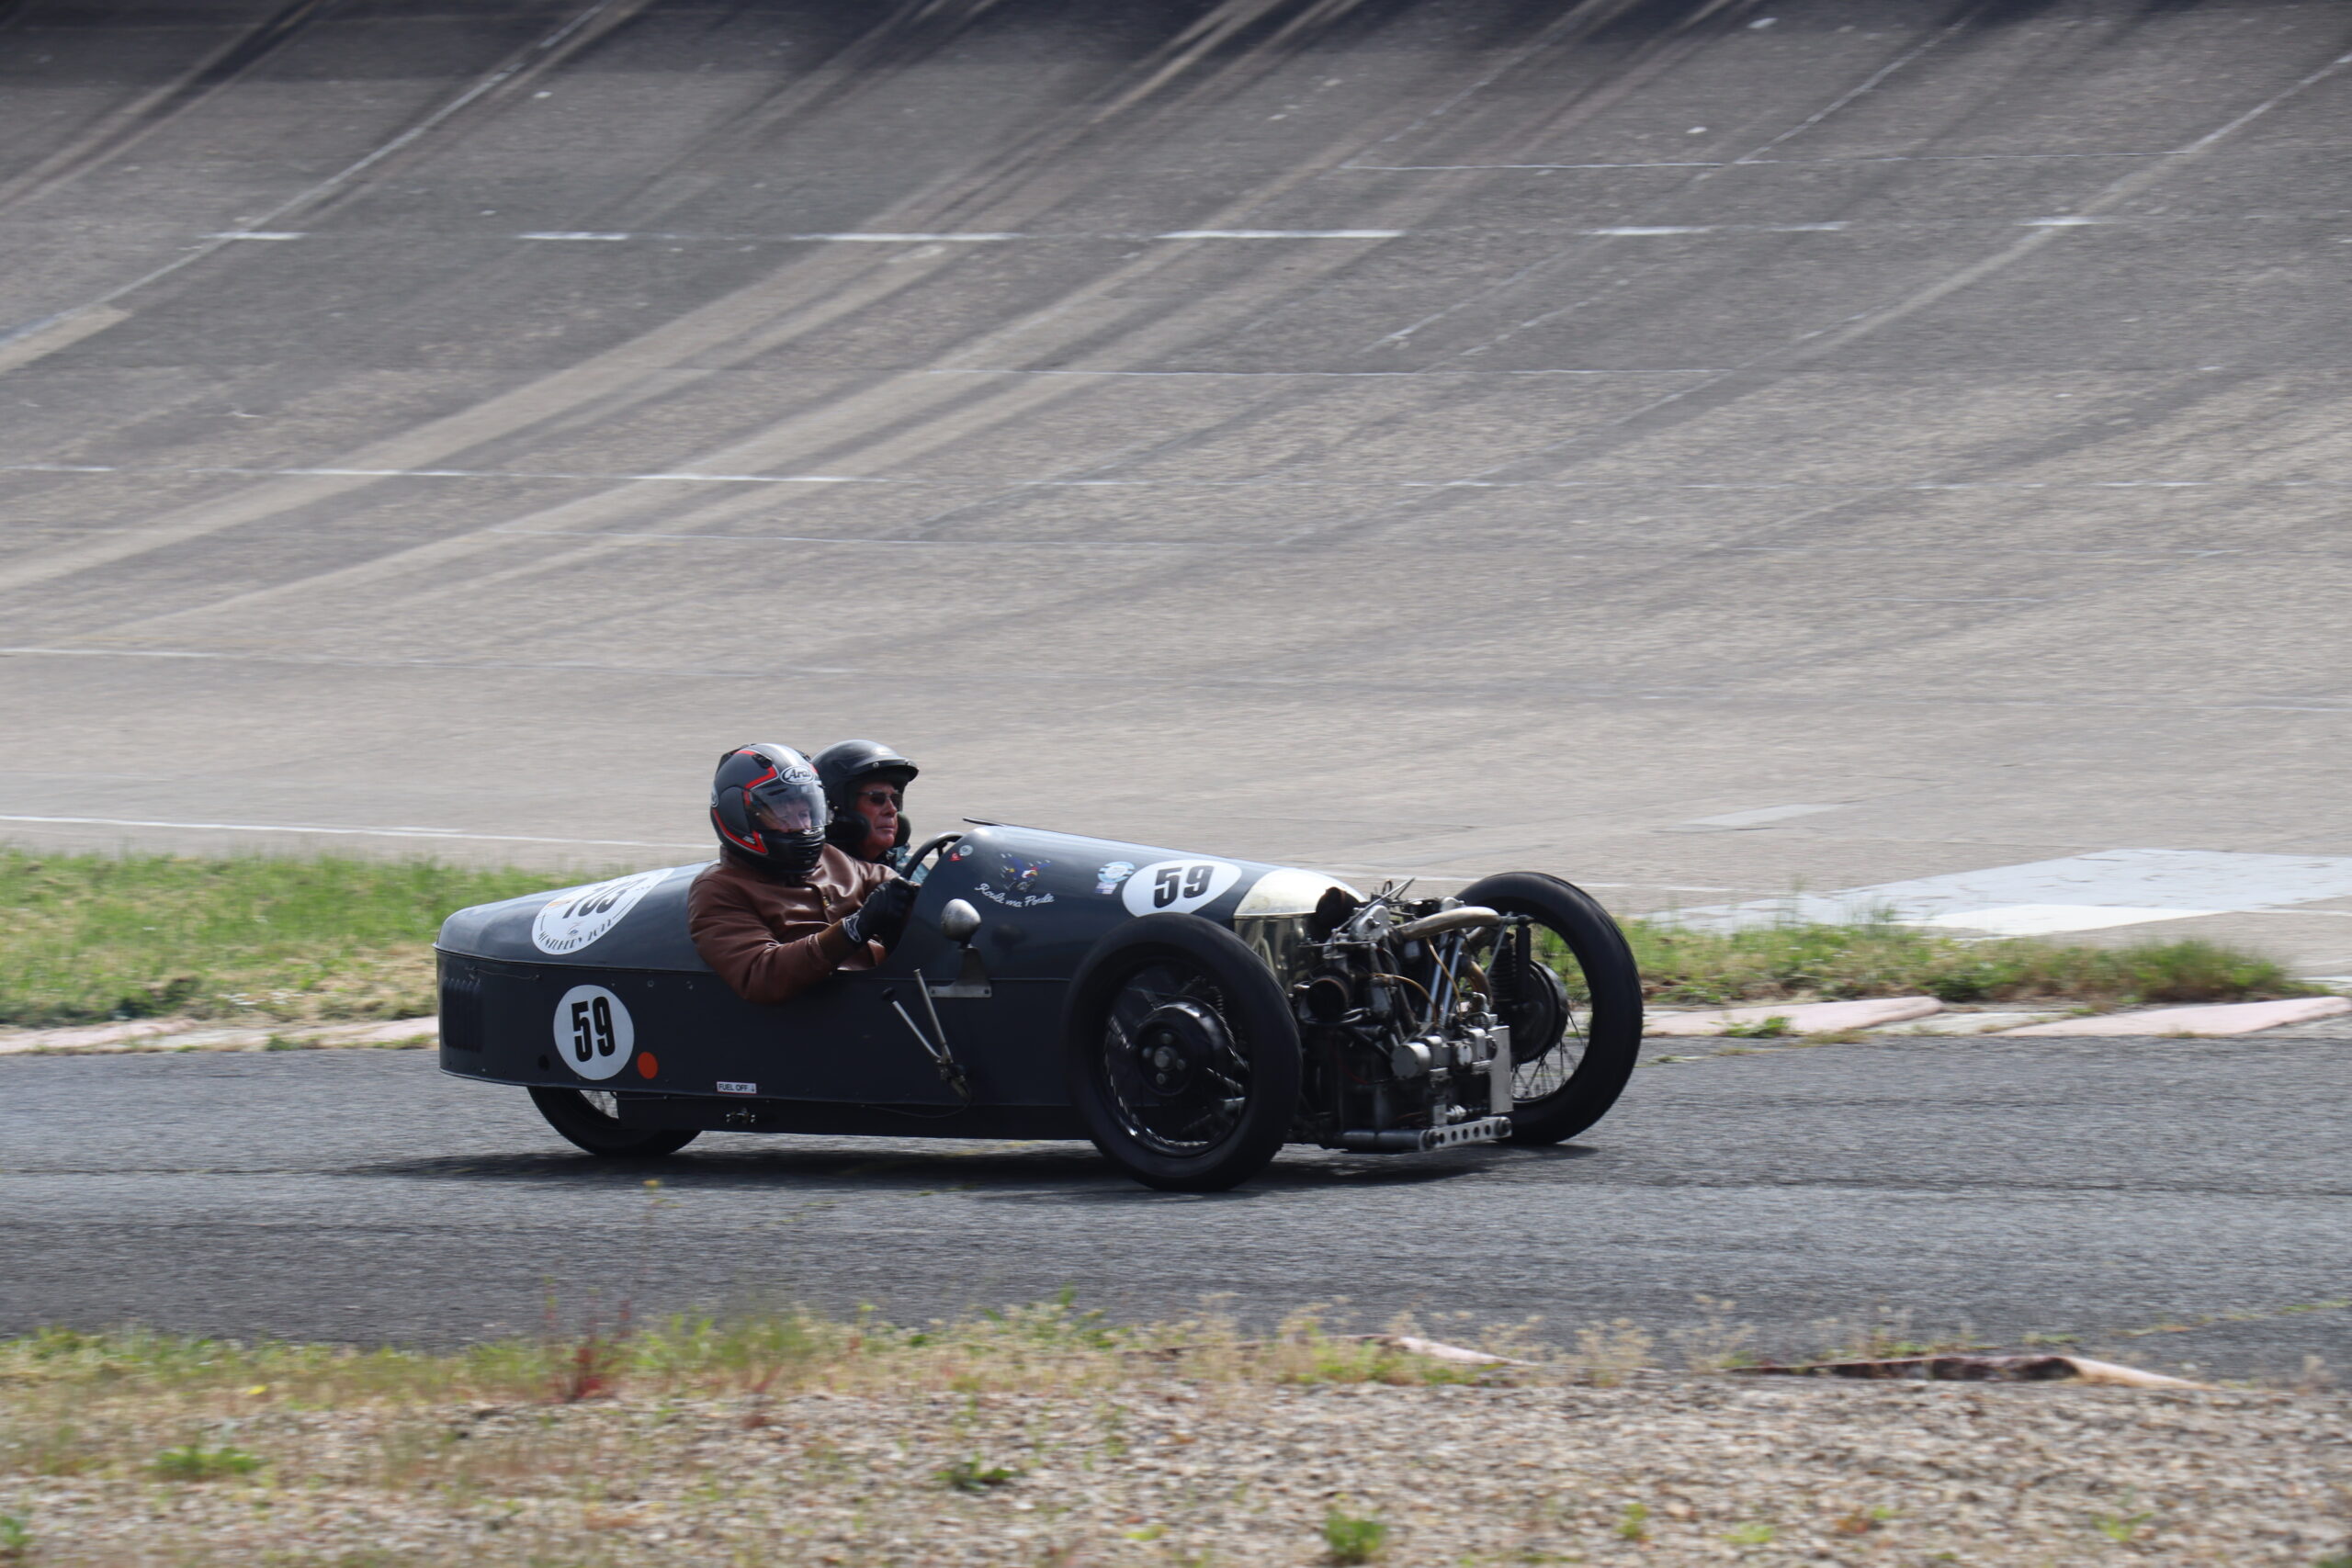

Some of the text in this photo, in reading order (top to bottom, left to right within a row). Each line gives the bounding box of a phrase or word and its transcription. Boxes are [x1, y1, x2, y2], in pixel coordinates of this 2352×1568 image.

[1153, 865, 1214, 908] 59
[1005, 899, 1023, 908] ma
[571, 996, 616, 1062] 59
[718, 1083, 735, 1091] FUEL
